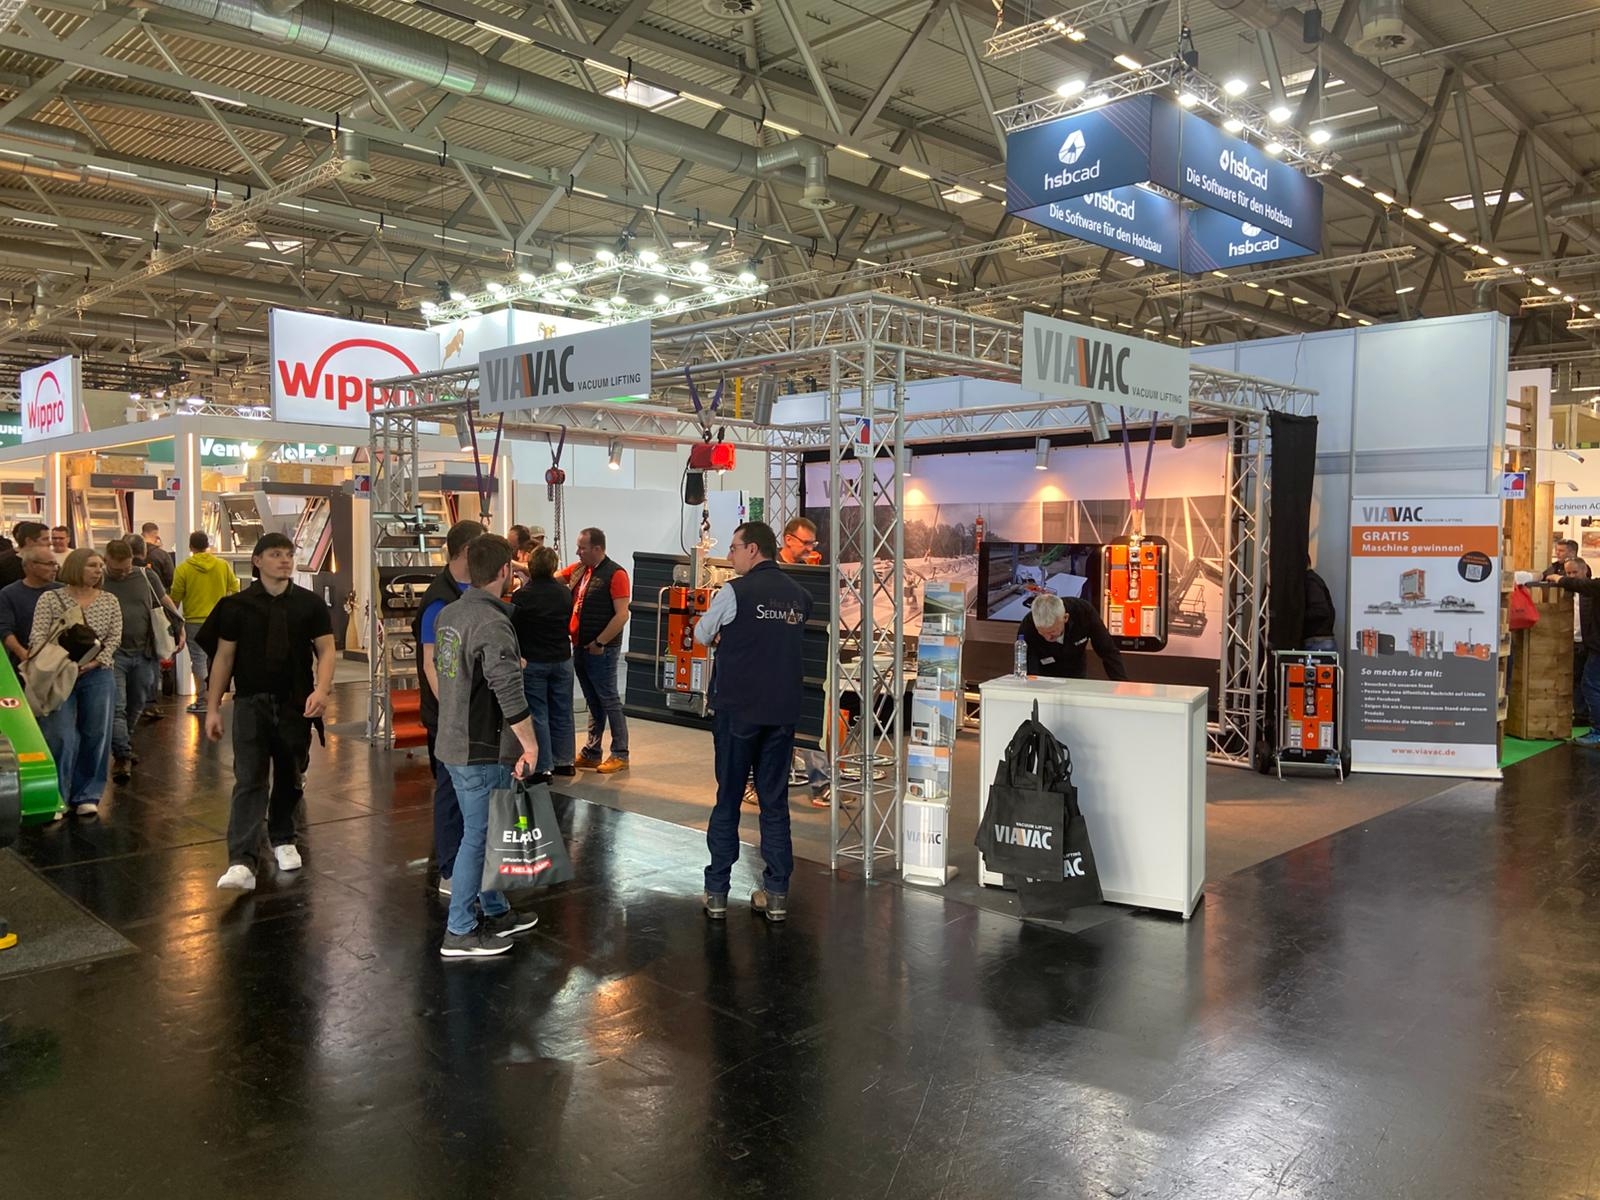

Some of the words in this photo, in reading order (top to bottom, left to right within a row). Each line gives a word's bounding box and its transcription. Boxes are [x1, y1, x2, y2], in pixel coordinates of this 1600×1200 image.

[1044, 160, 1101, 190] hsbcad
[1230, 151, 1269, 191] hsbcad
[1094, 190, 1135, 220] hsbcad
[1186, 167, 1201, 187] Die
[1201, 175, 1237, 203] Software
[1237, 190, 1250, 208] für
[1250, 197, 1264, 216] den
[1265, 204, 1293, 228] Holzbau
[1049, 203, 1064, 220] Die
[1065, 208, 1102, 233] Software
[1103, 221, 1115, 238] für
[1116, 227, 1131, 244] den
[1132, 232, 1162, 253] Holzbau
[1228, 236, 1279, 257] hsbcad
[486, 345, 575, 402] VIAVAC
[577, 377, 609, 391] VACUUM
[611, 373, 641, 387] LIFTING
[1033, 327, 1131, 395] VIAVAC
[1132, 387, 1159, 401] VACUUM
[1160, 391, 1183, 404] LIFTING
[27, 400, 64, 434] Wippro
[1362, 507, 1423, 522] VIAVAC
[1362, 531, 1410, 541] GRATIS
[1362, 544, 1408, 552] Maschine
[1411, 544, 1464, 553] gewinnen!
[1409, 669, 1423, 677] Sie
[1425, 669, 1443, 677] mit:
[1391, 748, 1456, 756] www.viavac.de
[994, 824, 1053, 850] VIAVAC
